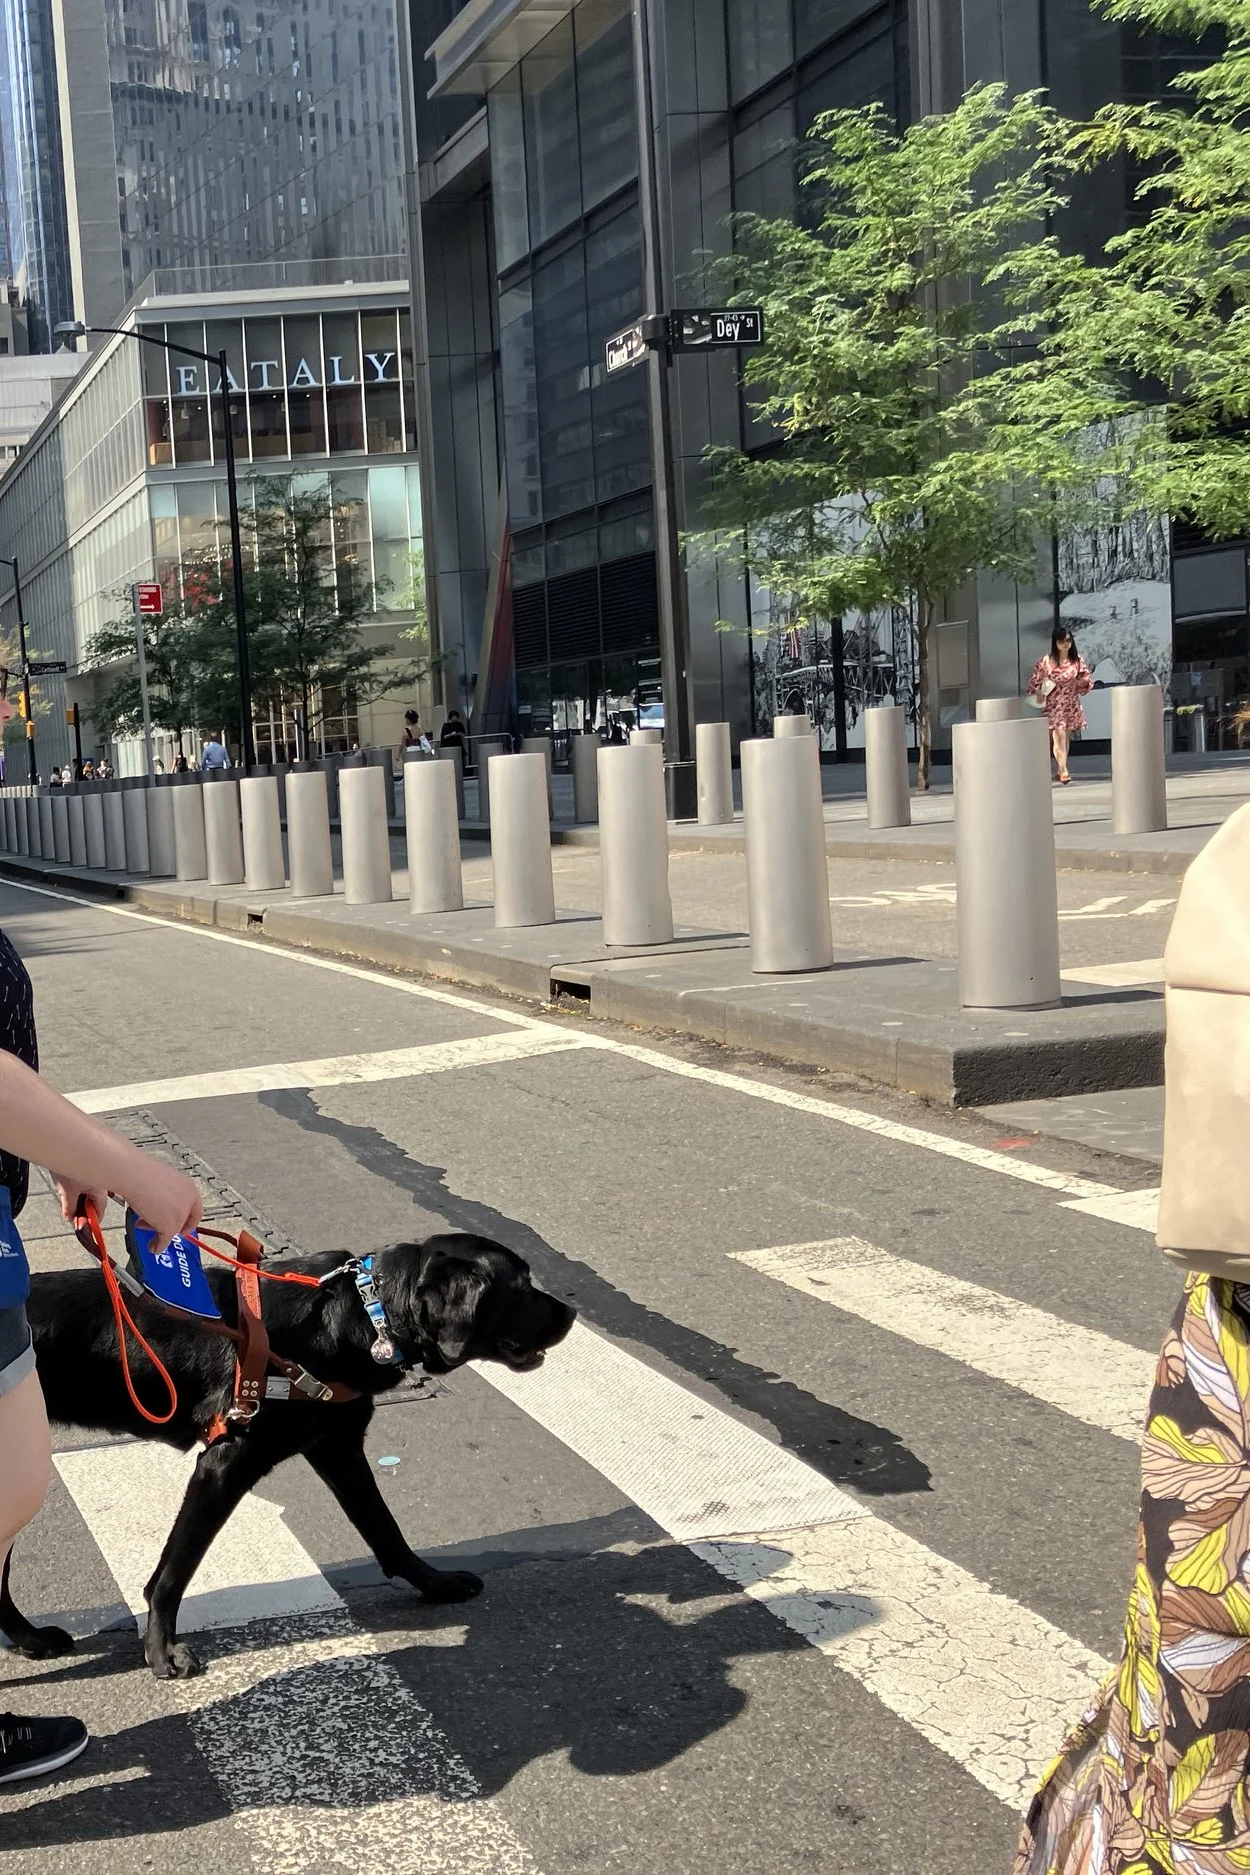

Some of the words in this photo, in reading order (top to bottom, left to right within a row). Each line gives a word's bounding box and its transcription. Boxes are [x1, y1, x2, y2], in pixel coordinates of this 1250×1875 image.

[716, 319, 740, 341] Dey
[176, 352, 395, 396] EATALY
[176, 1250, 191, 1287] GUIDE
